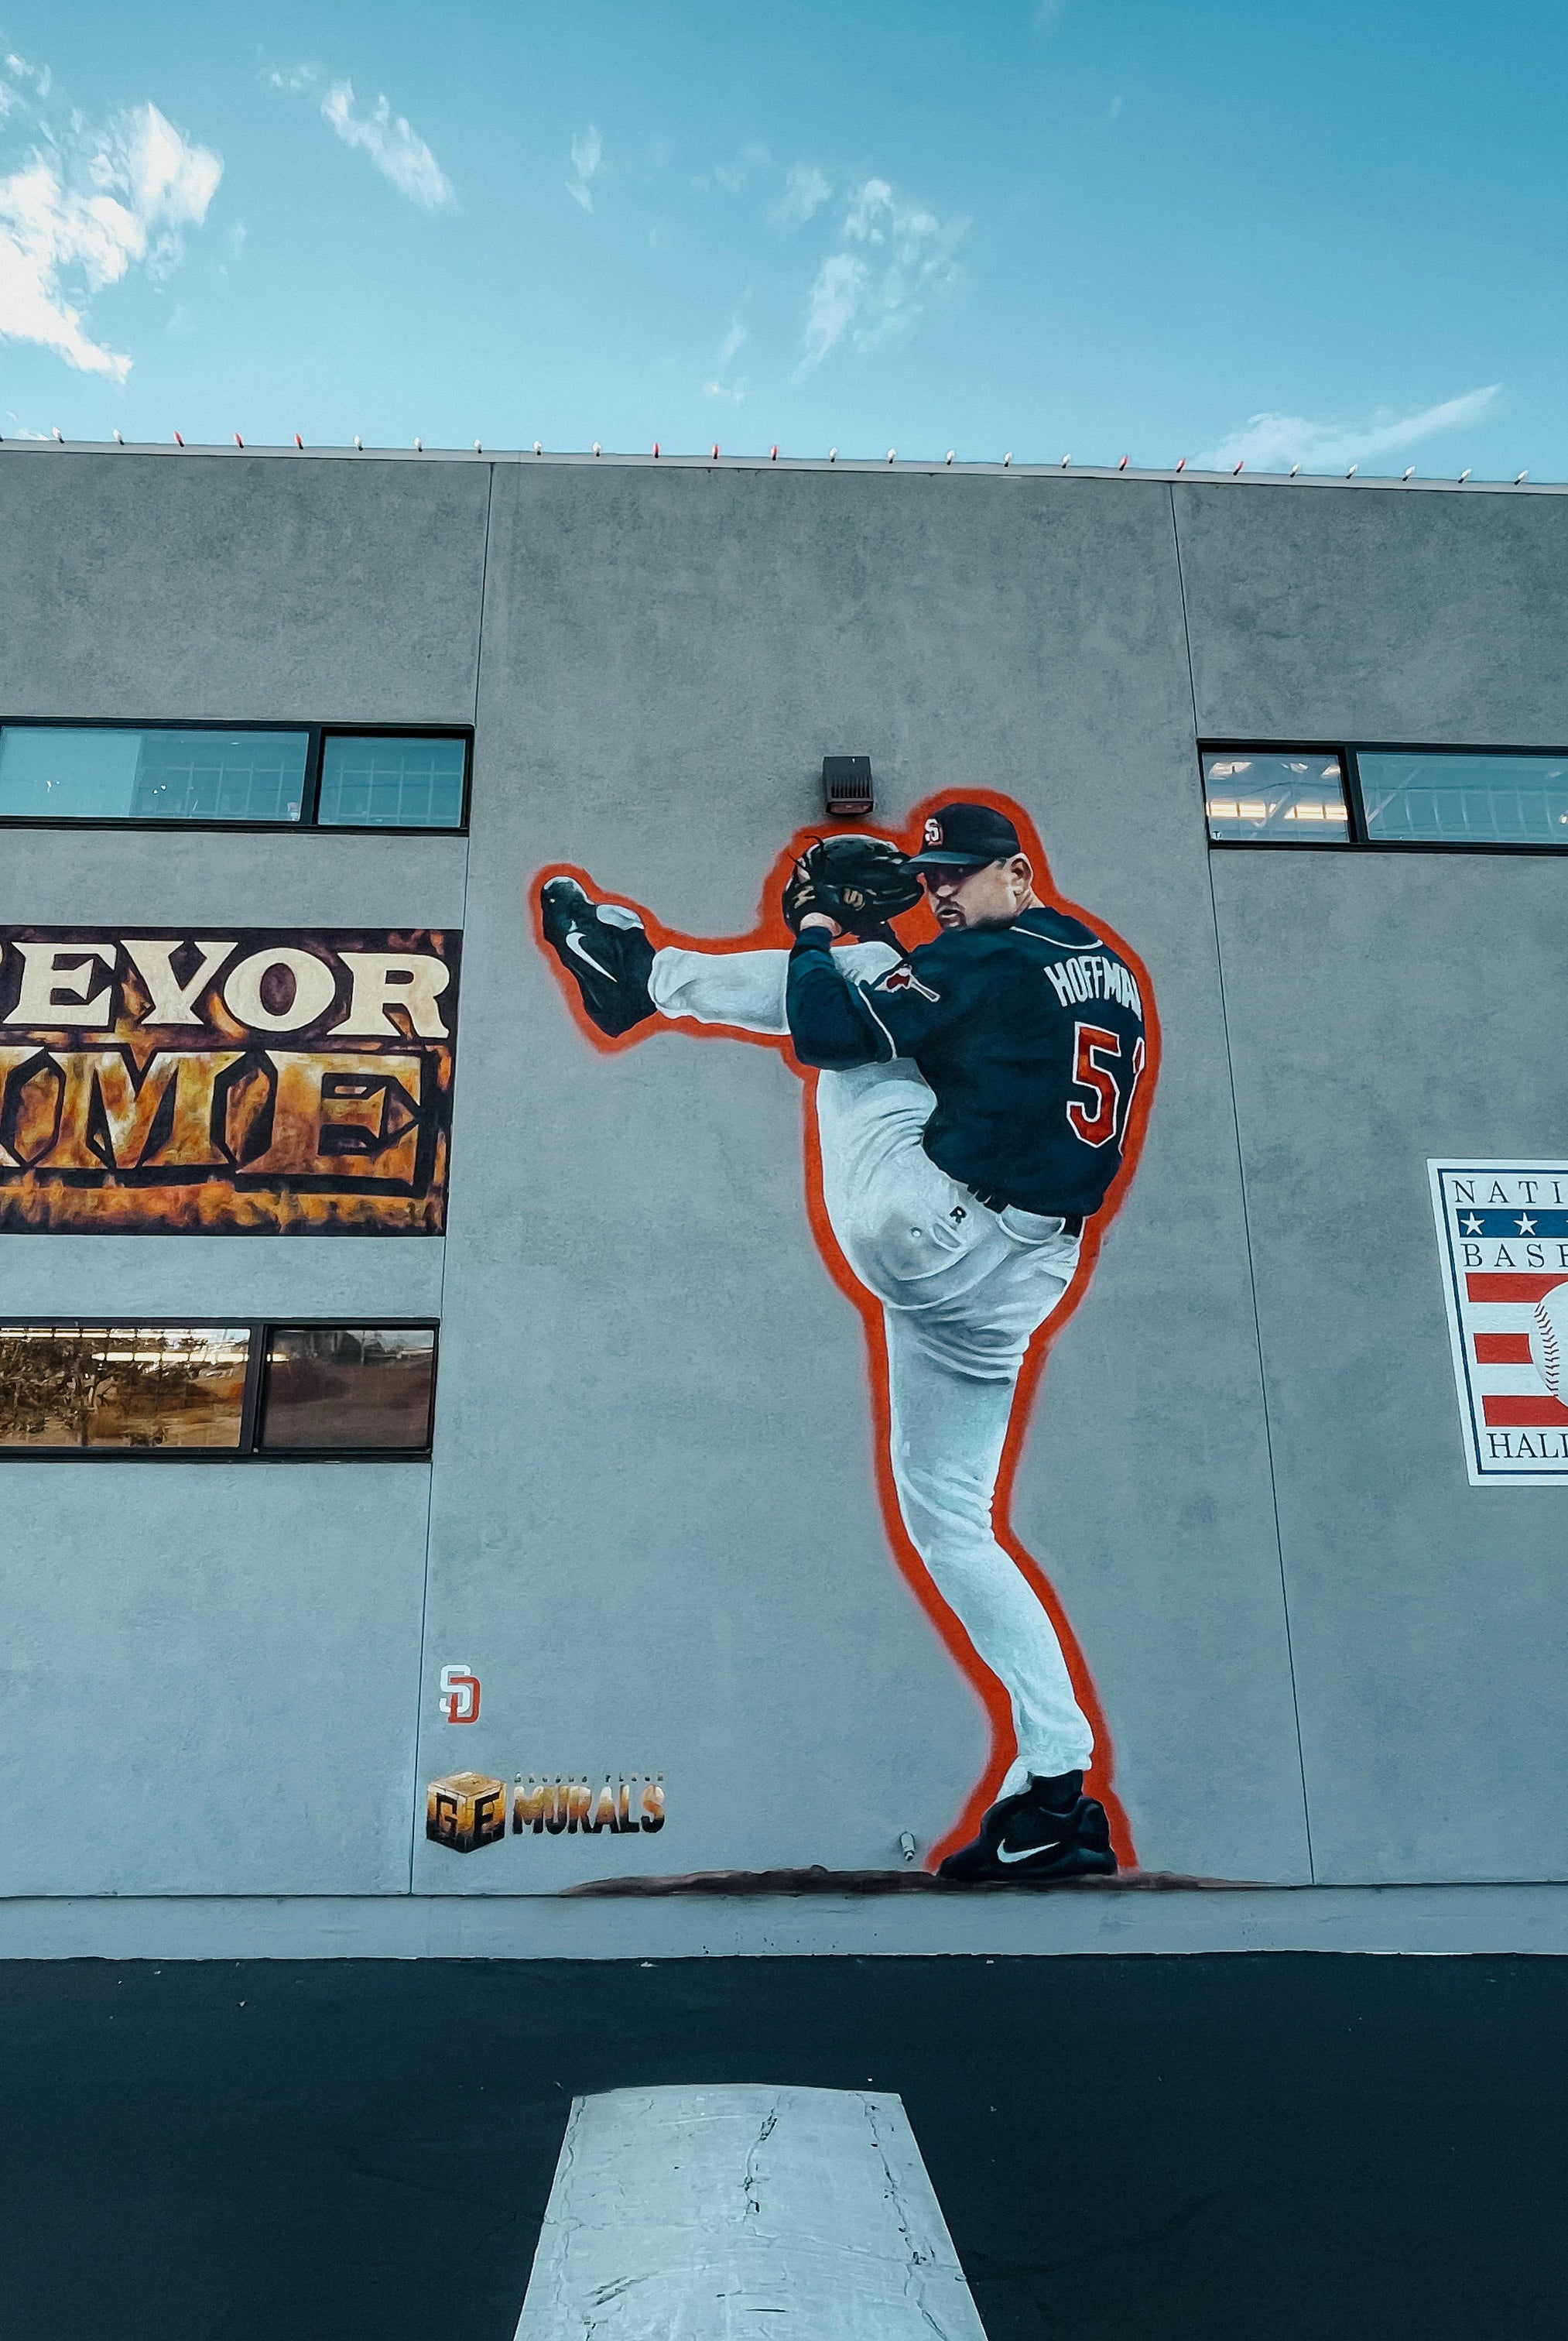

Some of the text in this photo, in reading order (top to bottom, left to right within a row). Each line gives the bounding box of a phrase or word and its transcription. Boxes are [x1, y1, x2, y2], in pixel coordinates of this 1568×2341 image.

[0, 940, 450, 1038] EVOR
[438, 1664, 481, 1724] SD
[512, 1784, 666, 1835] MURALS
